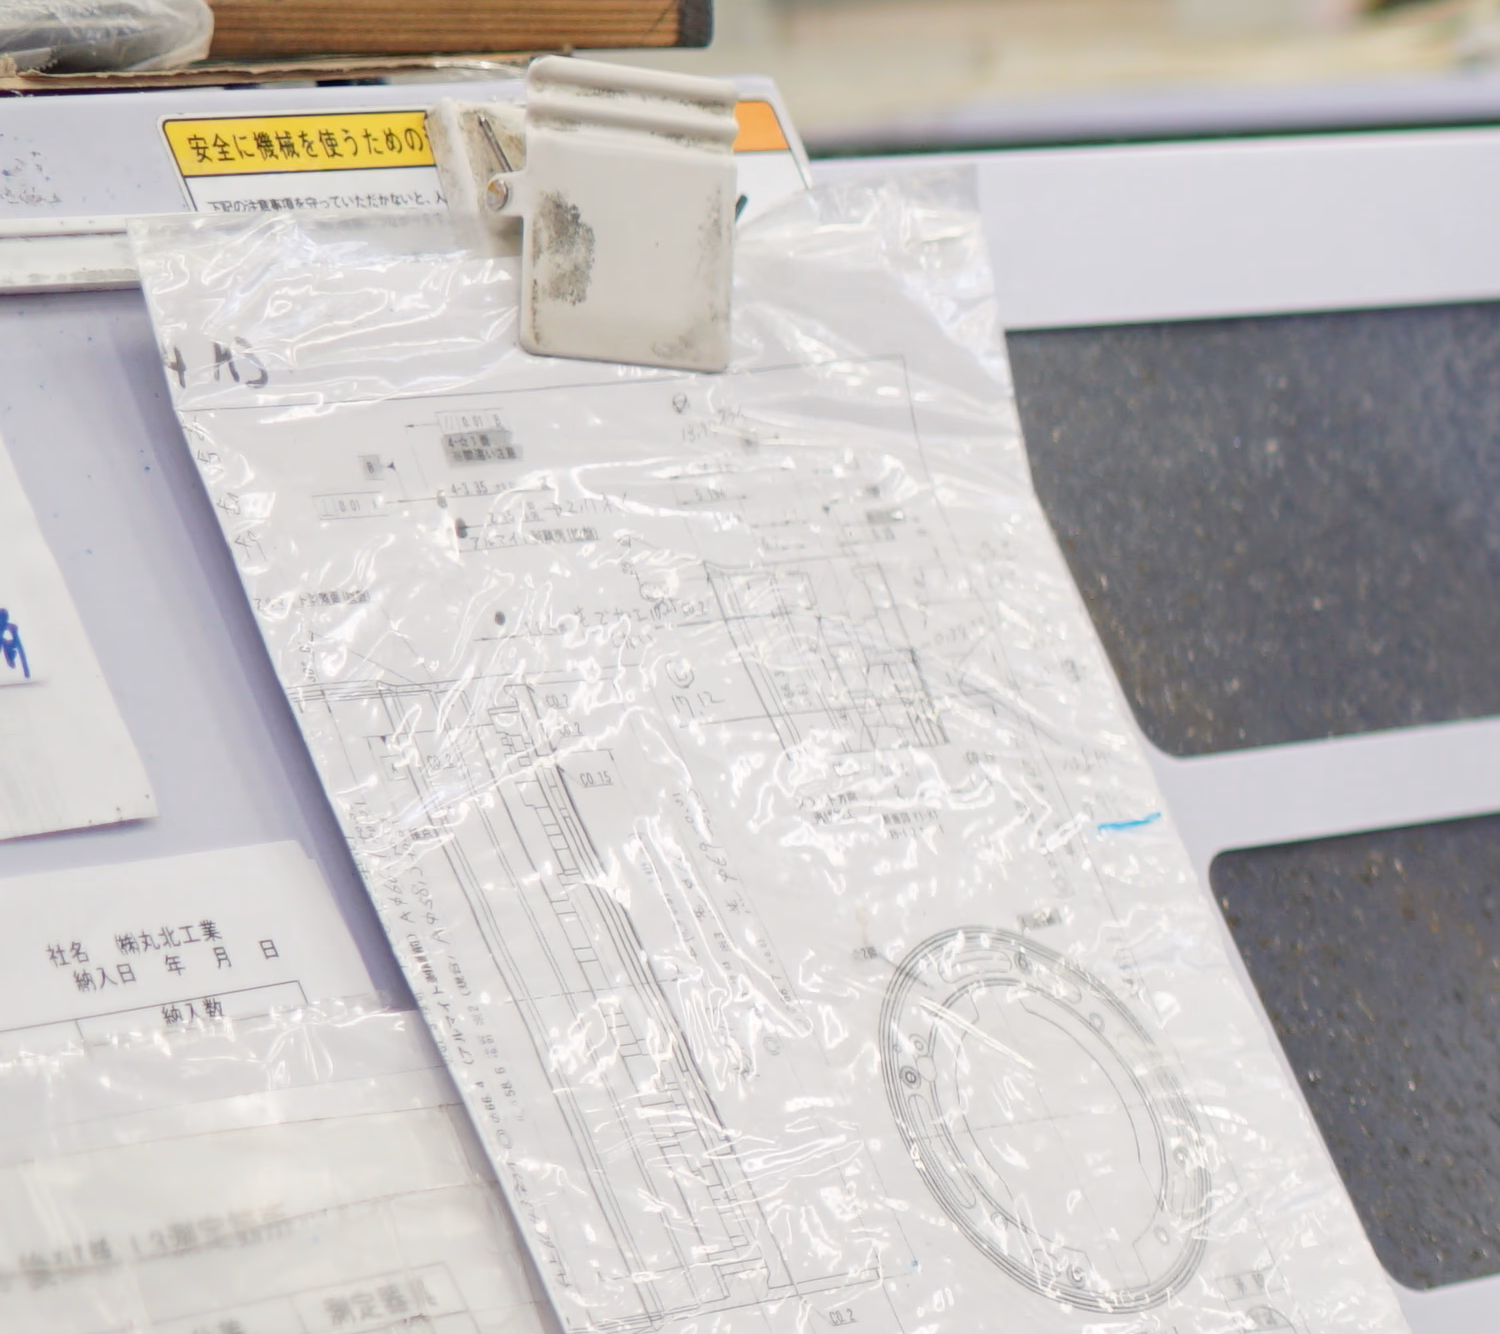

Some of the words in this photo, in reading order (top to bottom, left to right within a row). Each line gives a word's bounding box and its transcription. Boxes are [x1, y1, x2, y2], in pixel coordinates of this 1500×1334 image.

[187, 126, 429, 164] 安全に機械を使うための
[46, 940, 90, 968] 社名
[72, 962, 137, 993] 納入日
[164, 954, 187, 977] 年
[212, 945, 233, 970] 月
[258, 939, 280, 960] 日
[161, 997, 224, 1027] 納入数
